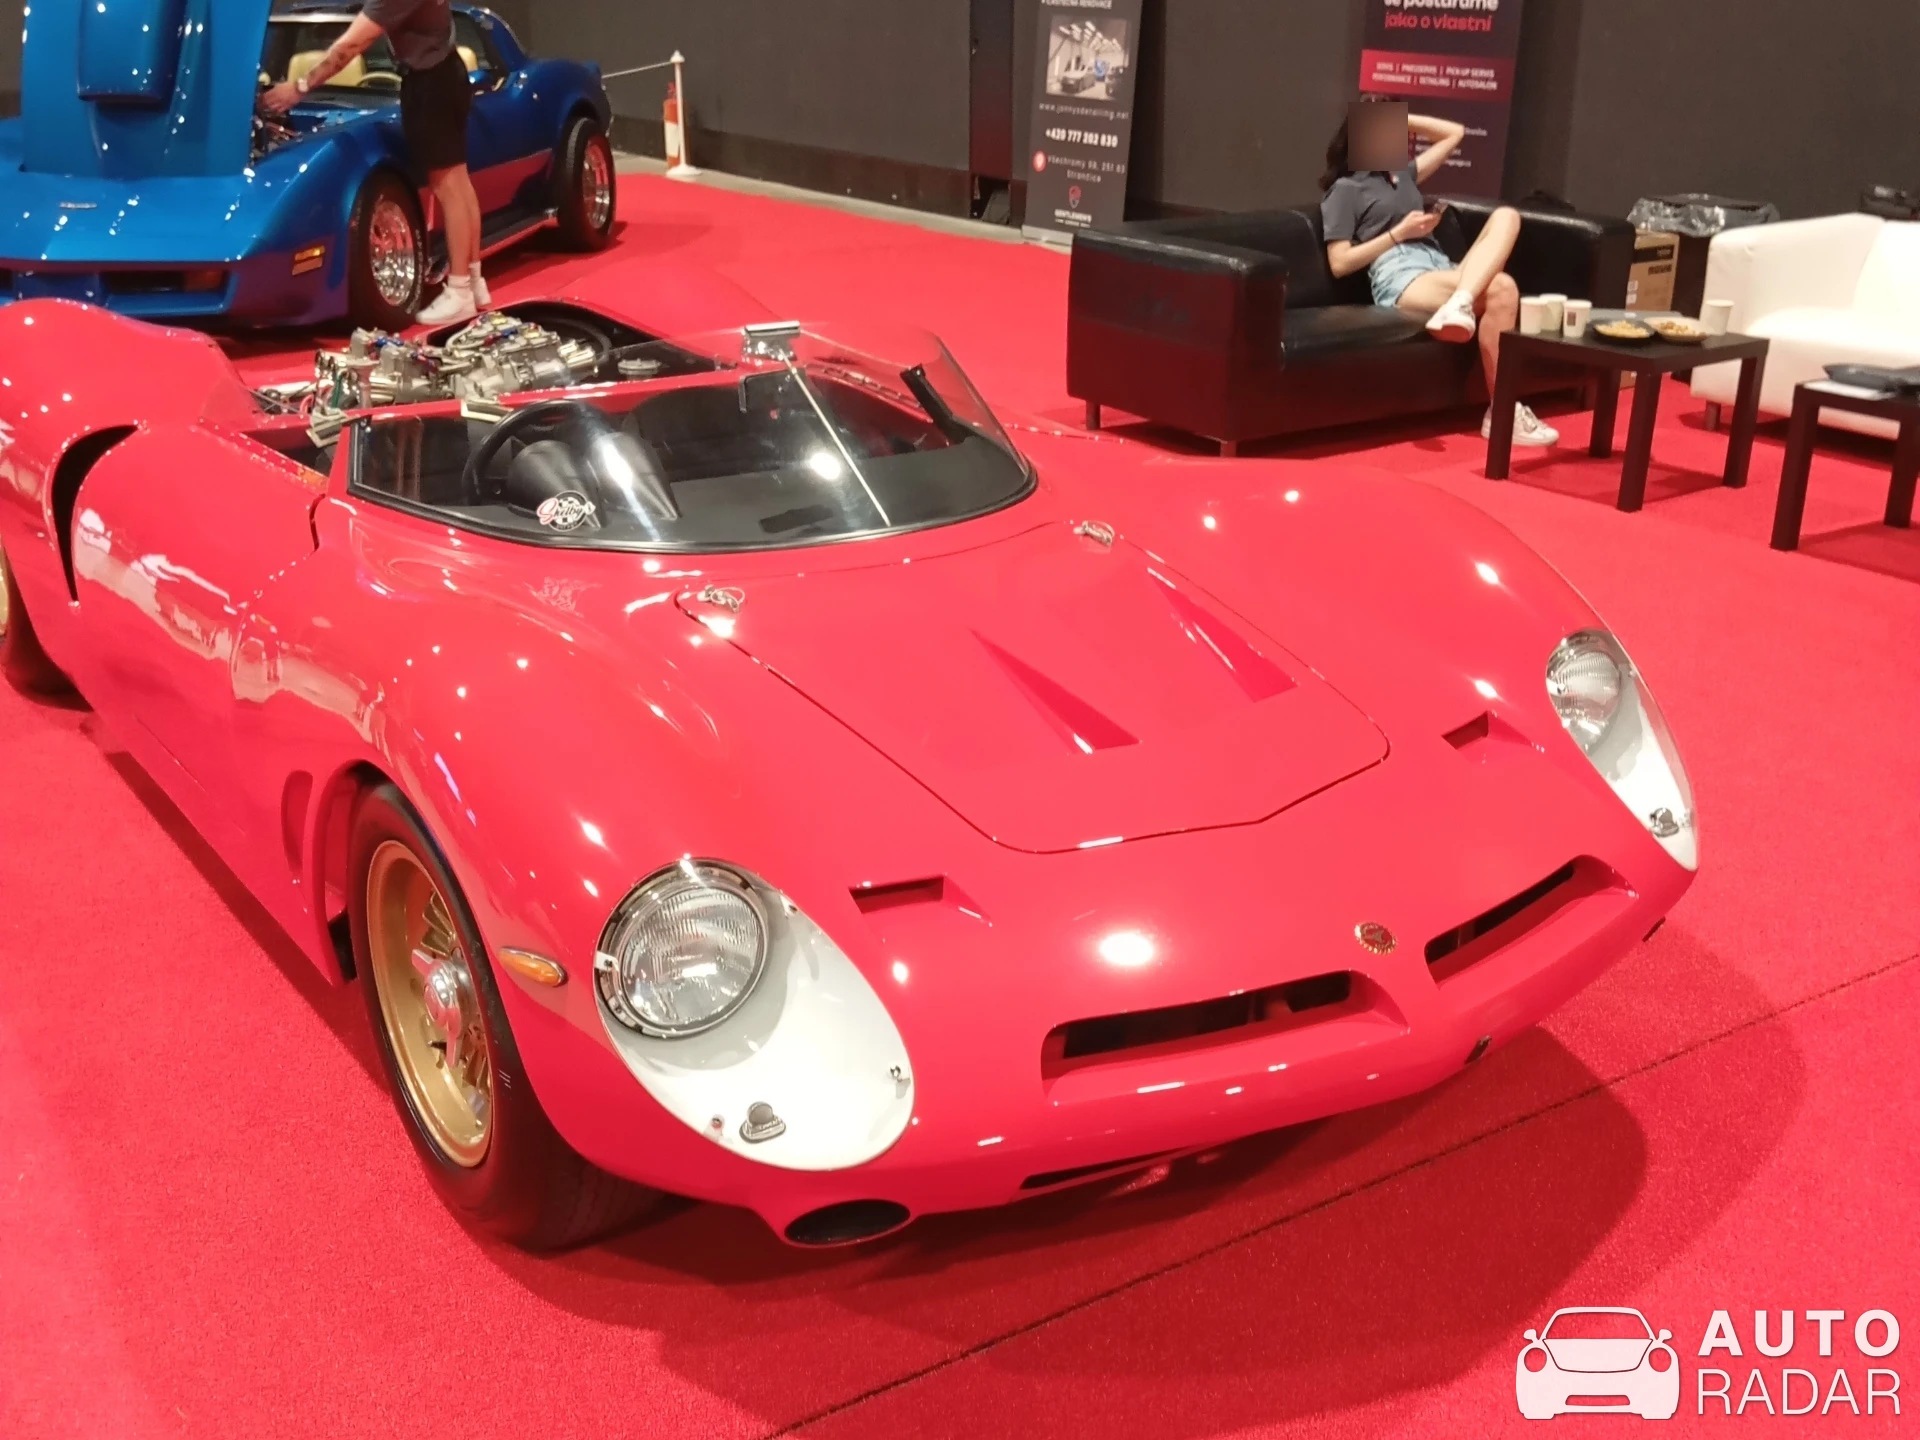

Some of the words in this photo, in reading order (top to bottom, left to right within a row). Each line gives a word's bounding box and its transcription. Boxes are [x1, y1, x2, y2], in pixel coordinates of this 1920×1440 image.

[1384, 11, 1418, 29] jako
[1420, 15, 1431, 29] o
[1433, 13, 1493, 31] vlastní
[1045, 127, 1066, 141] +420
[1067, 129, 1082, 142] 777
